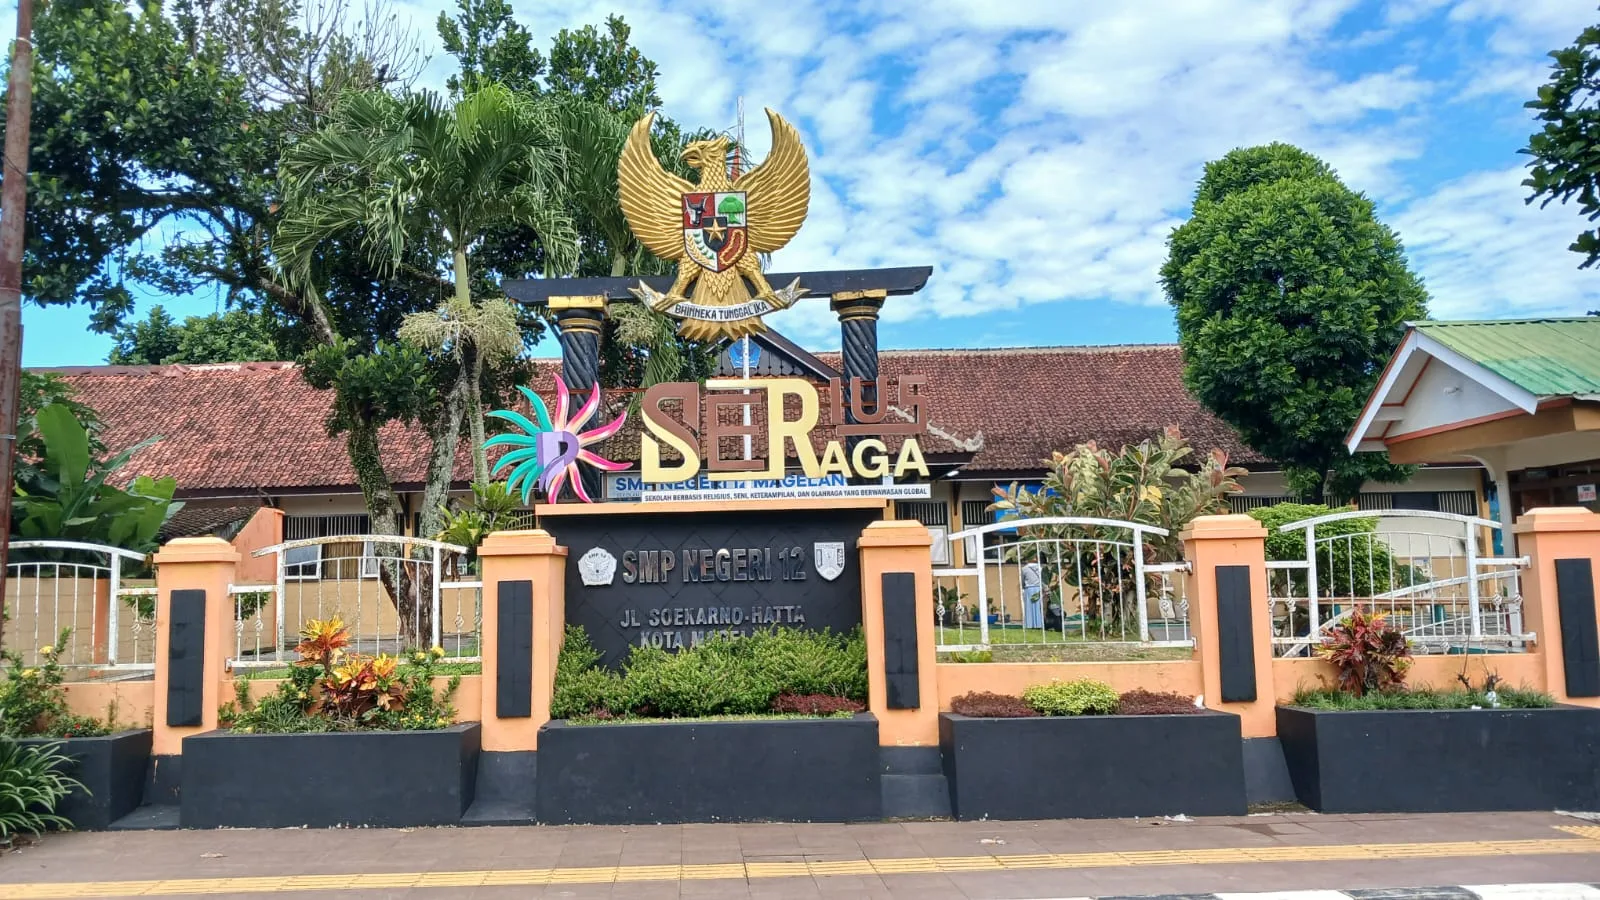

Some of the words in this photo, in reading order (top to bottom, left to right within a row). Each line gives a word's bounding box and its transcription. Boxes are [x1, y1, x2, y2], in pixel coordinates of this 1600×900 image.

[675, 303, 716, 320] BHINNEKA
[719, 303, 753, 319] TUNGGAL
[754, 301, 768, 314] IKA
[753, 473, 846, 489] MAGELAN
[645, 494, 672, 502] SEKOLAH
[673, 493, 702, 501] BERBASIS
[844, 489, 860, 497] YANG
[860, 488, 903, 497] BERWAWASAN
[903, 487, 927, 495] GLOBAL
[622, 550, 676, 583] SMP
[682, 547, 772, 582] NEGERI
[778, 546, 807, 580] 12
[620, 609, 641, 628] JL
[648, 605, 806, 627] SOEKARNO-HATTA
[640, 631, 683, 649] KOTA
